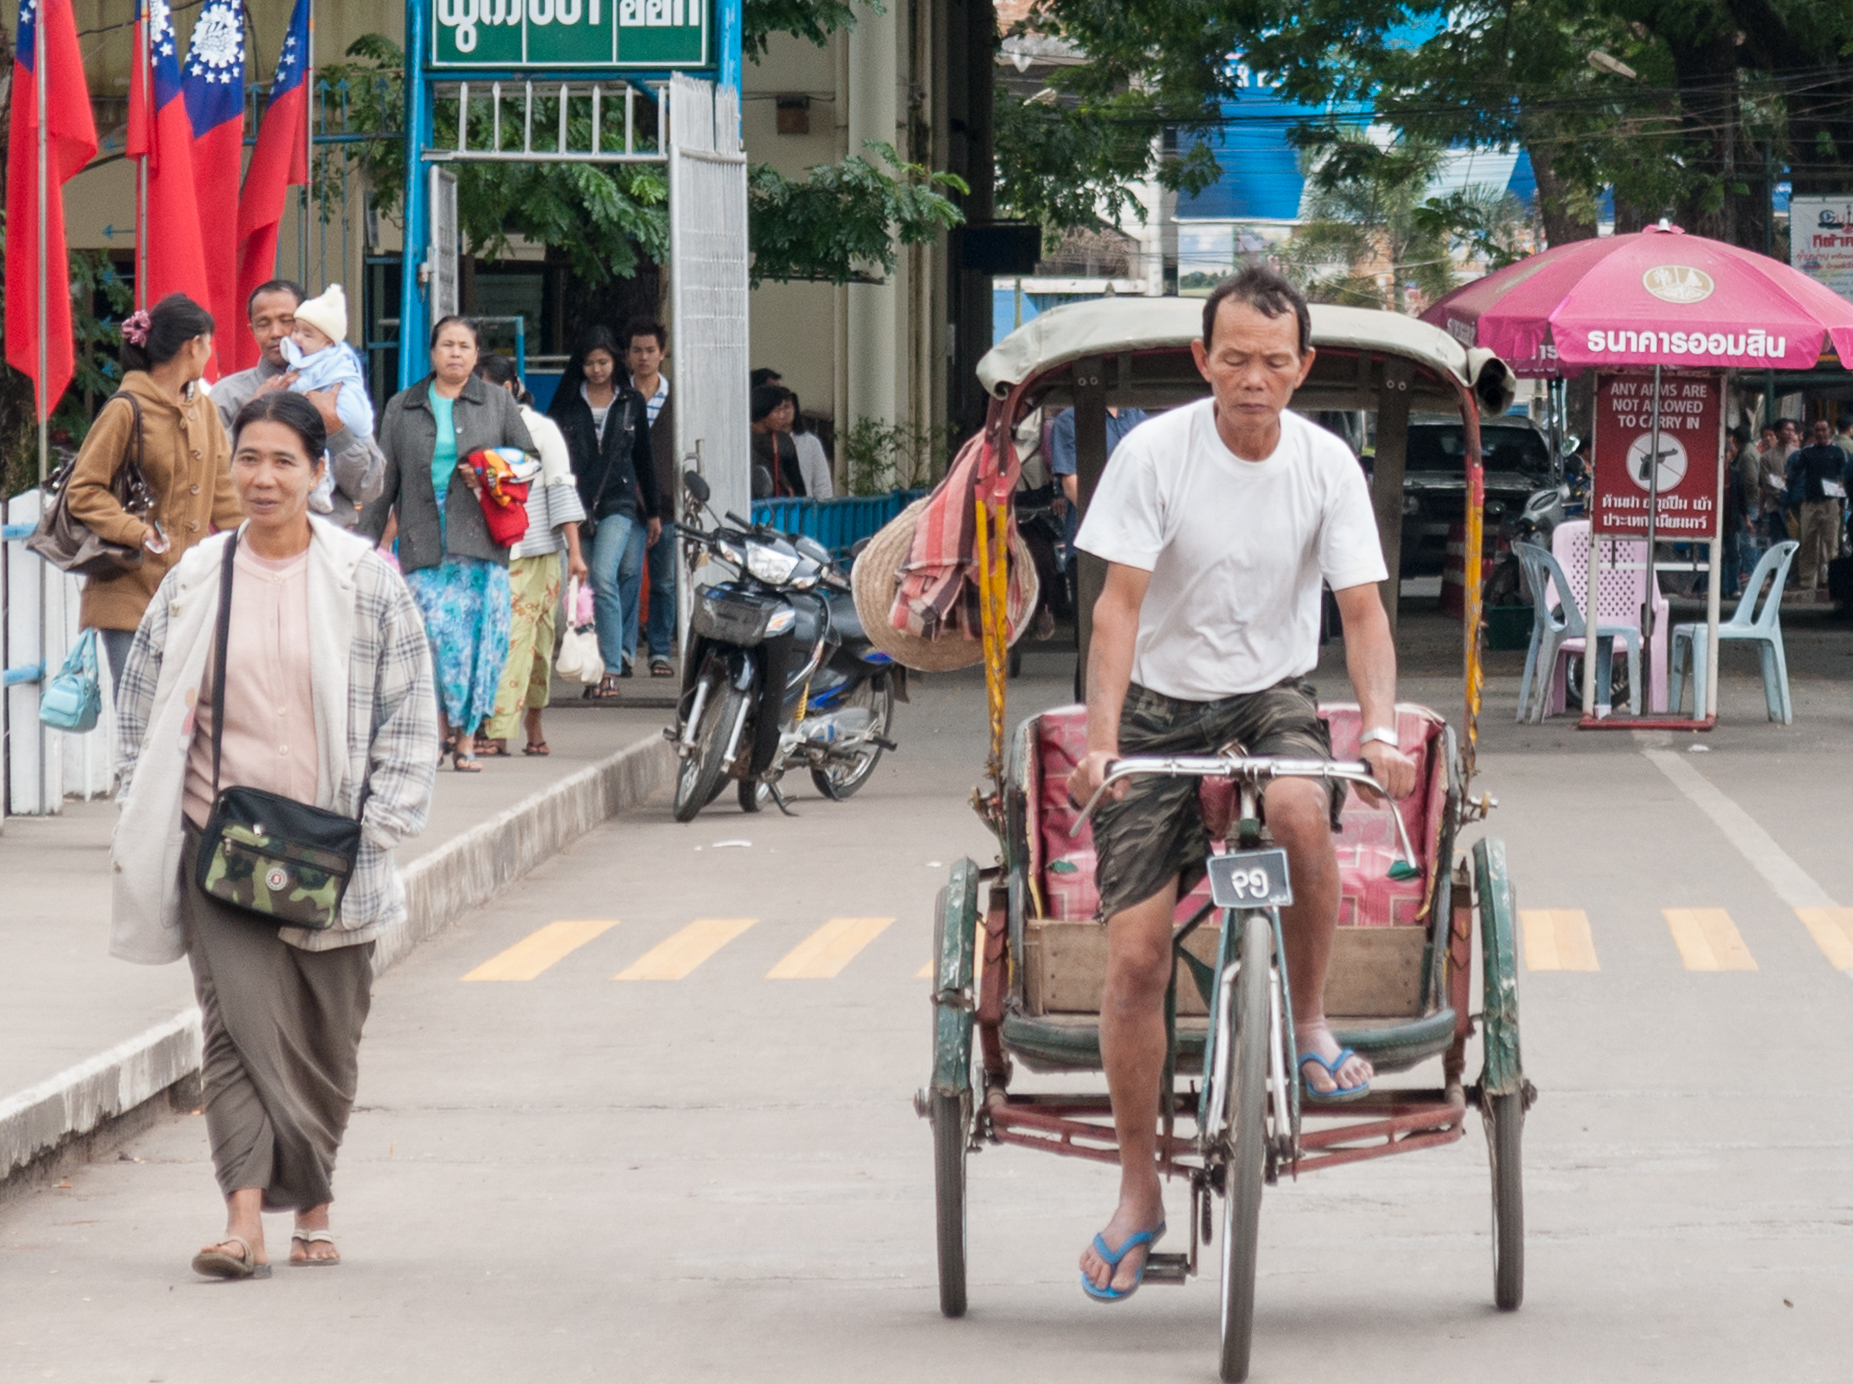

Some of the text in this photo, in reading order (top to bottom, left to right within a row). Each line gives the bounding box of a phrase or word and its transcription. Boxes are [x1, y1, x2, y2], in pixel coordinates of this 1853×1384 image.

[1587, 328, 1786, 358] ธนาคารออมสิน
[1611, 382, 1637, 397] ANY
[1682, 384, 1707, 398] ARE
[1612, 399, 1703, 414] NOT ALOWED
[1618, 415, 1636, 428] TO
[1686, 416, 1700, 430] IN
